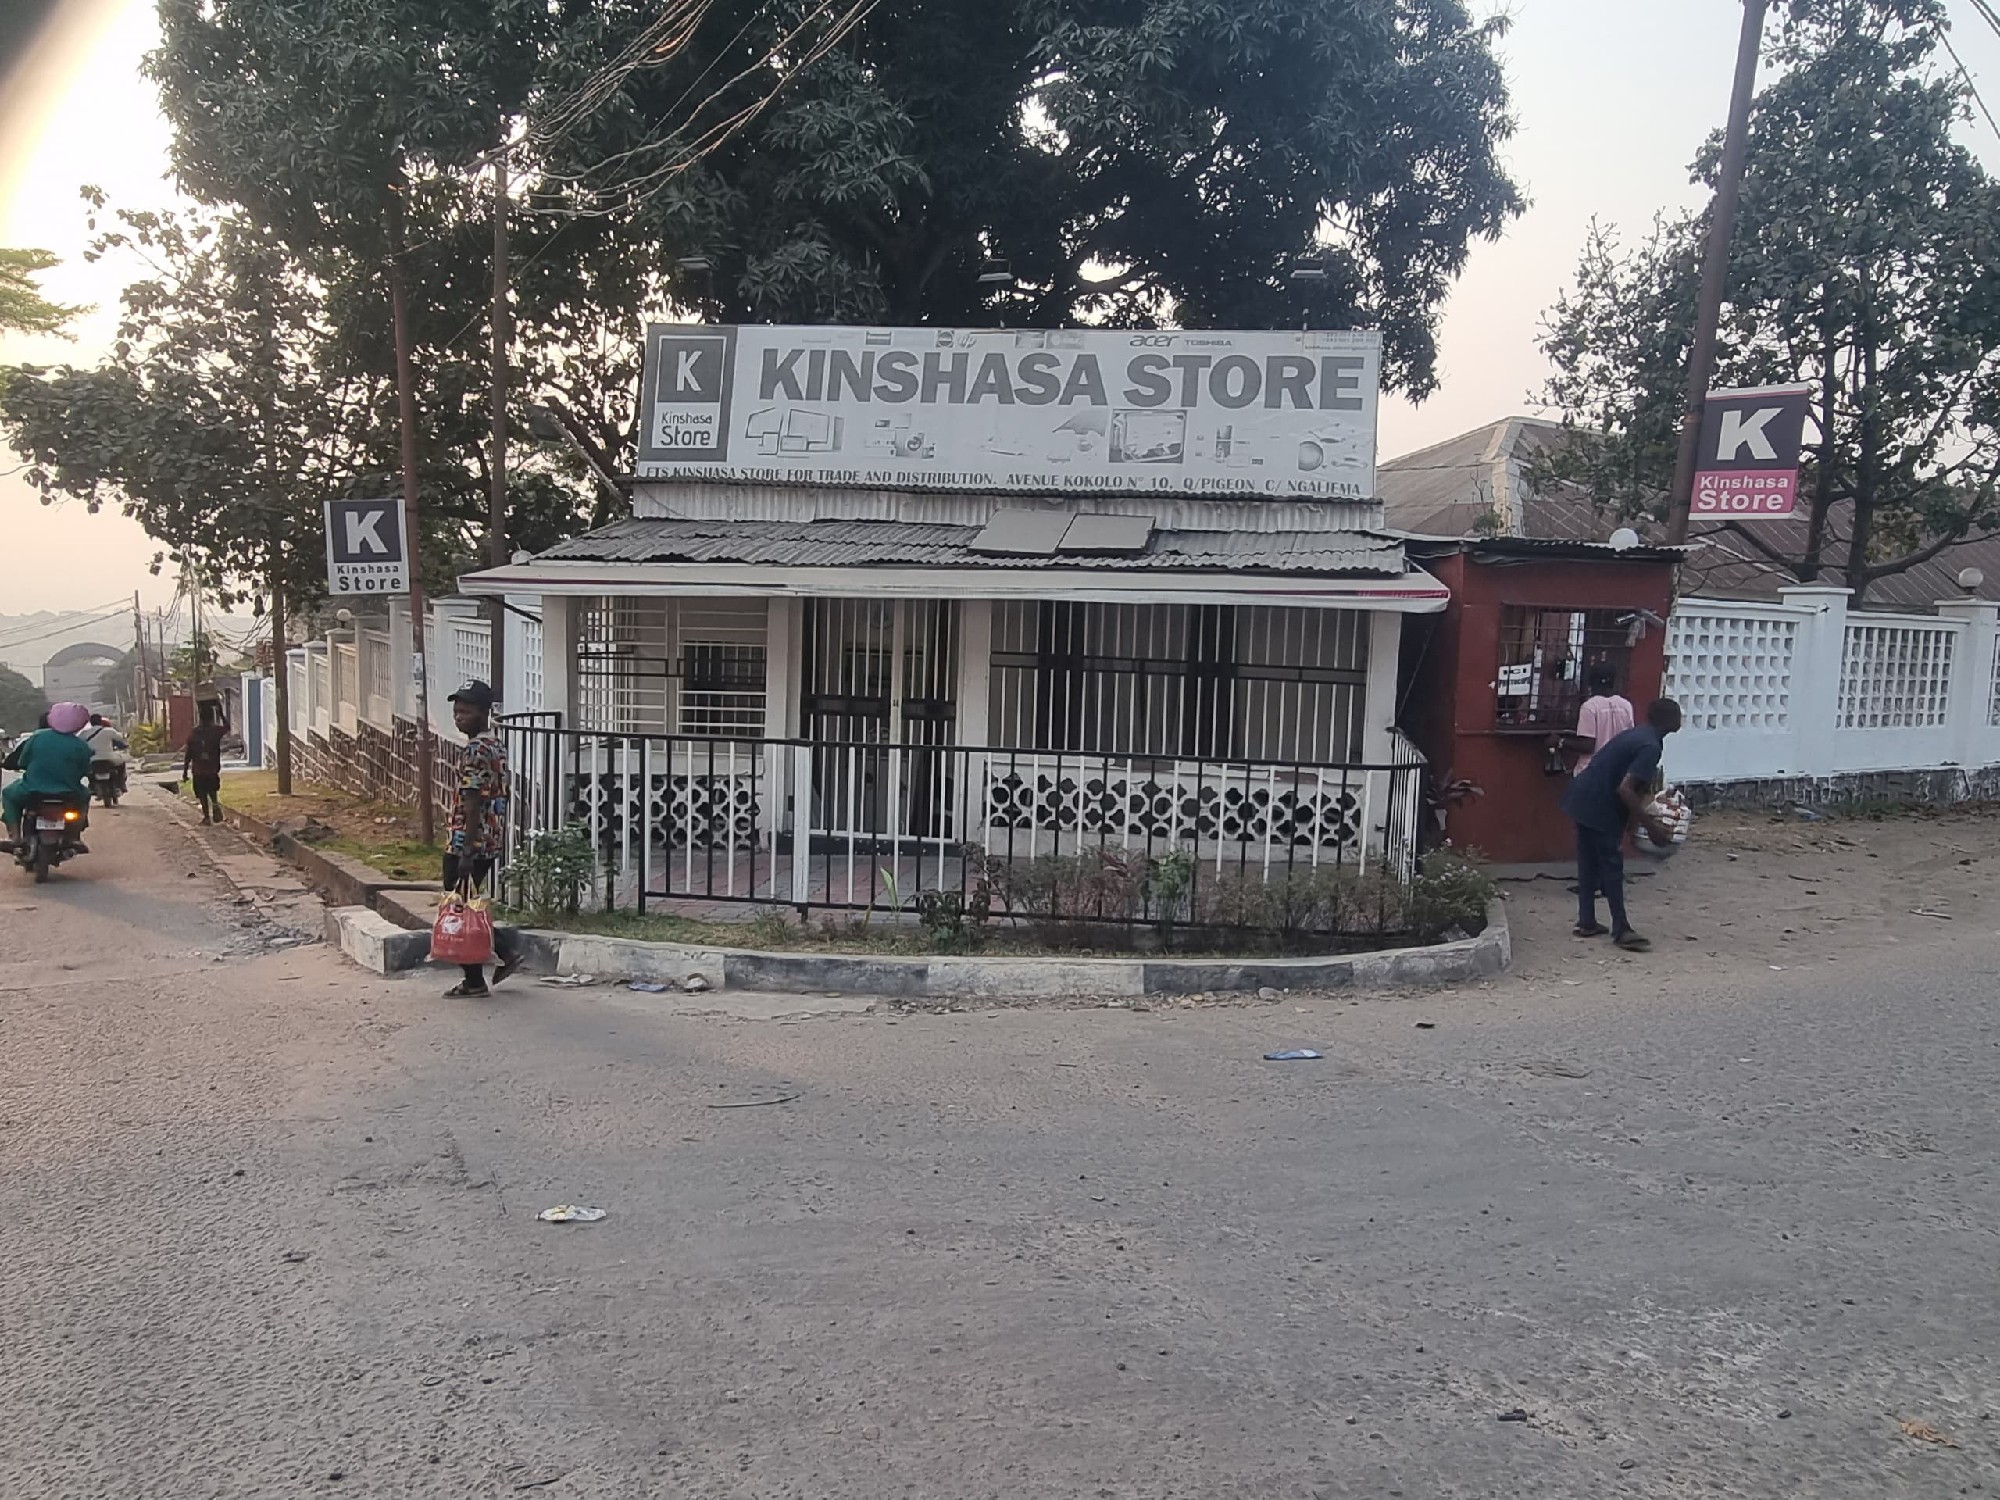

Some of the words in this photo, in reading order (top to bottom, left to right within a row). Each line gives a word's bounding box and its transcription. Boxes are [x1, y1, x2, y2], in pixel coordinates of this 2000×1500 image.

[1129, 335, 1180, 347] acer
[676, 351, 702, 391] K
[758, 348, 1109, 406] KINSHASA
[1122, 353, 1365, 410] STORE
[661, 411, 713, 425] Kinshasa
[660, 425, 711, 446] Store
[1716, 407, 1784, 460] K
[673, 466, 736, 479] KINSHASA
[740, 467, 782, 480] STORE
[787, 469, 813, 481] FOR
[817, 469, 861, 482] TRADE
[864, 470, 892, 482] AND
[896, 471, 997, 485] DISTRIBUTION.
[1006, 473, 1059, 486] AVENUE
[1063, 475, 1123, 487] KOKOLO
[1183, 477, 1256, 490] Q/PIGEON
[1265, 479, 1282, 492] C/
[1700, 475, 1789, 489] Kinshasa
[1697, 489, 1784, 510] Store
[344, 510, 389, 554] K
[337, 564, 399, 574] Kinshasa
[338, 576, 401, 591] Store
